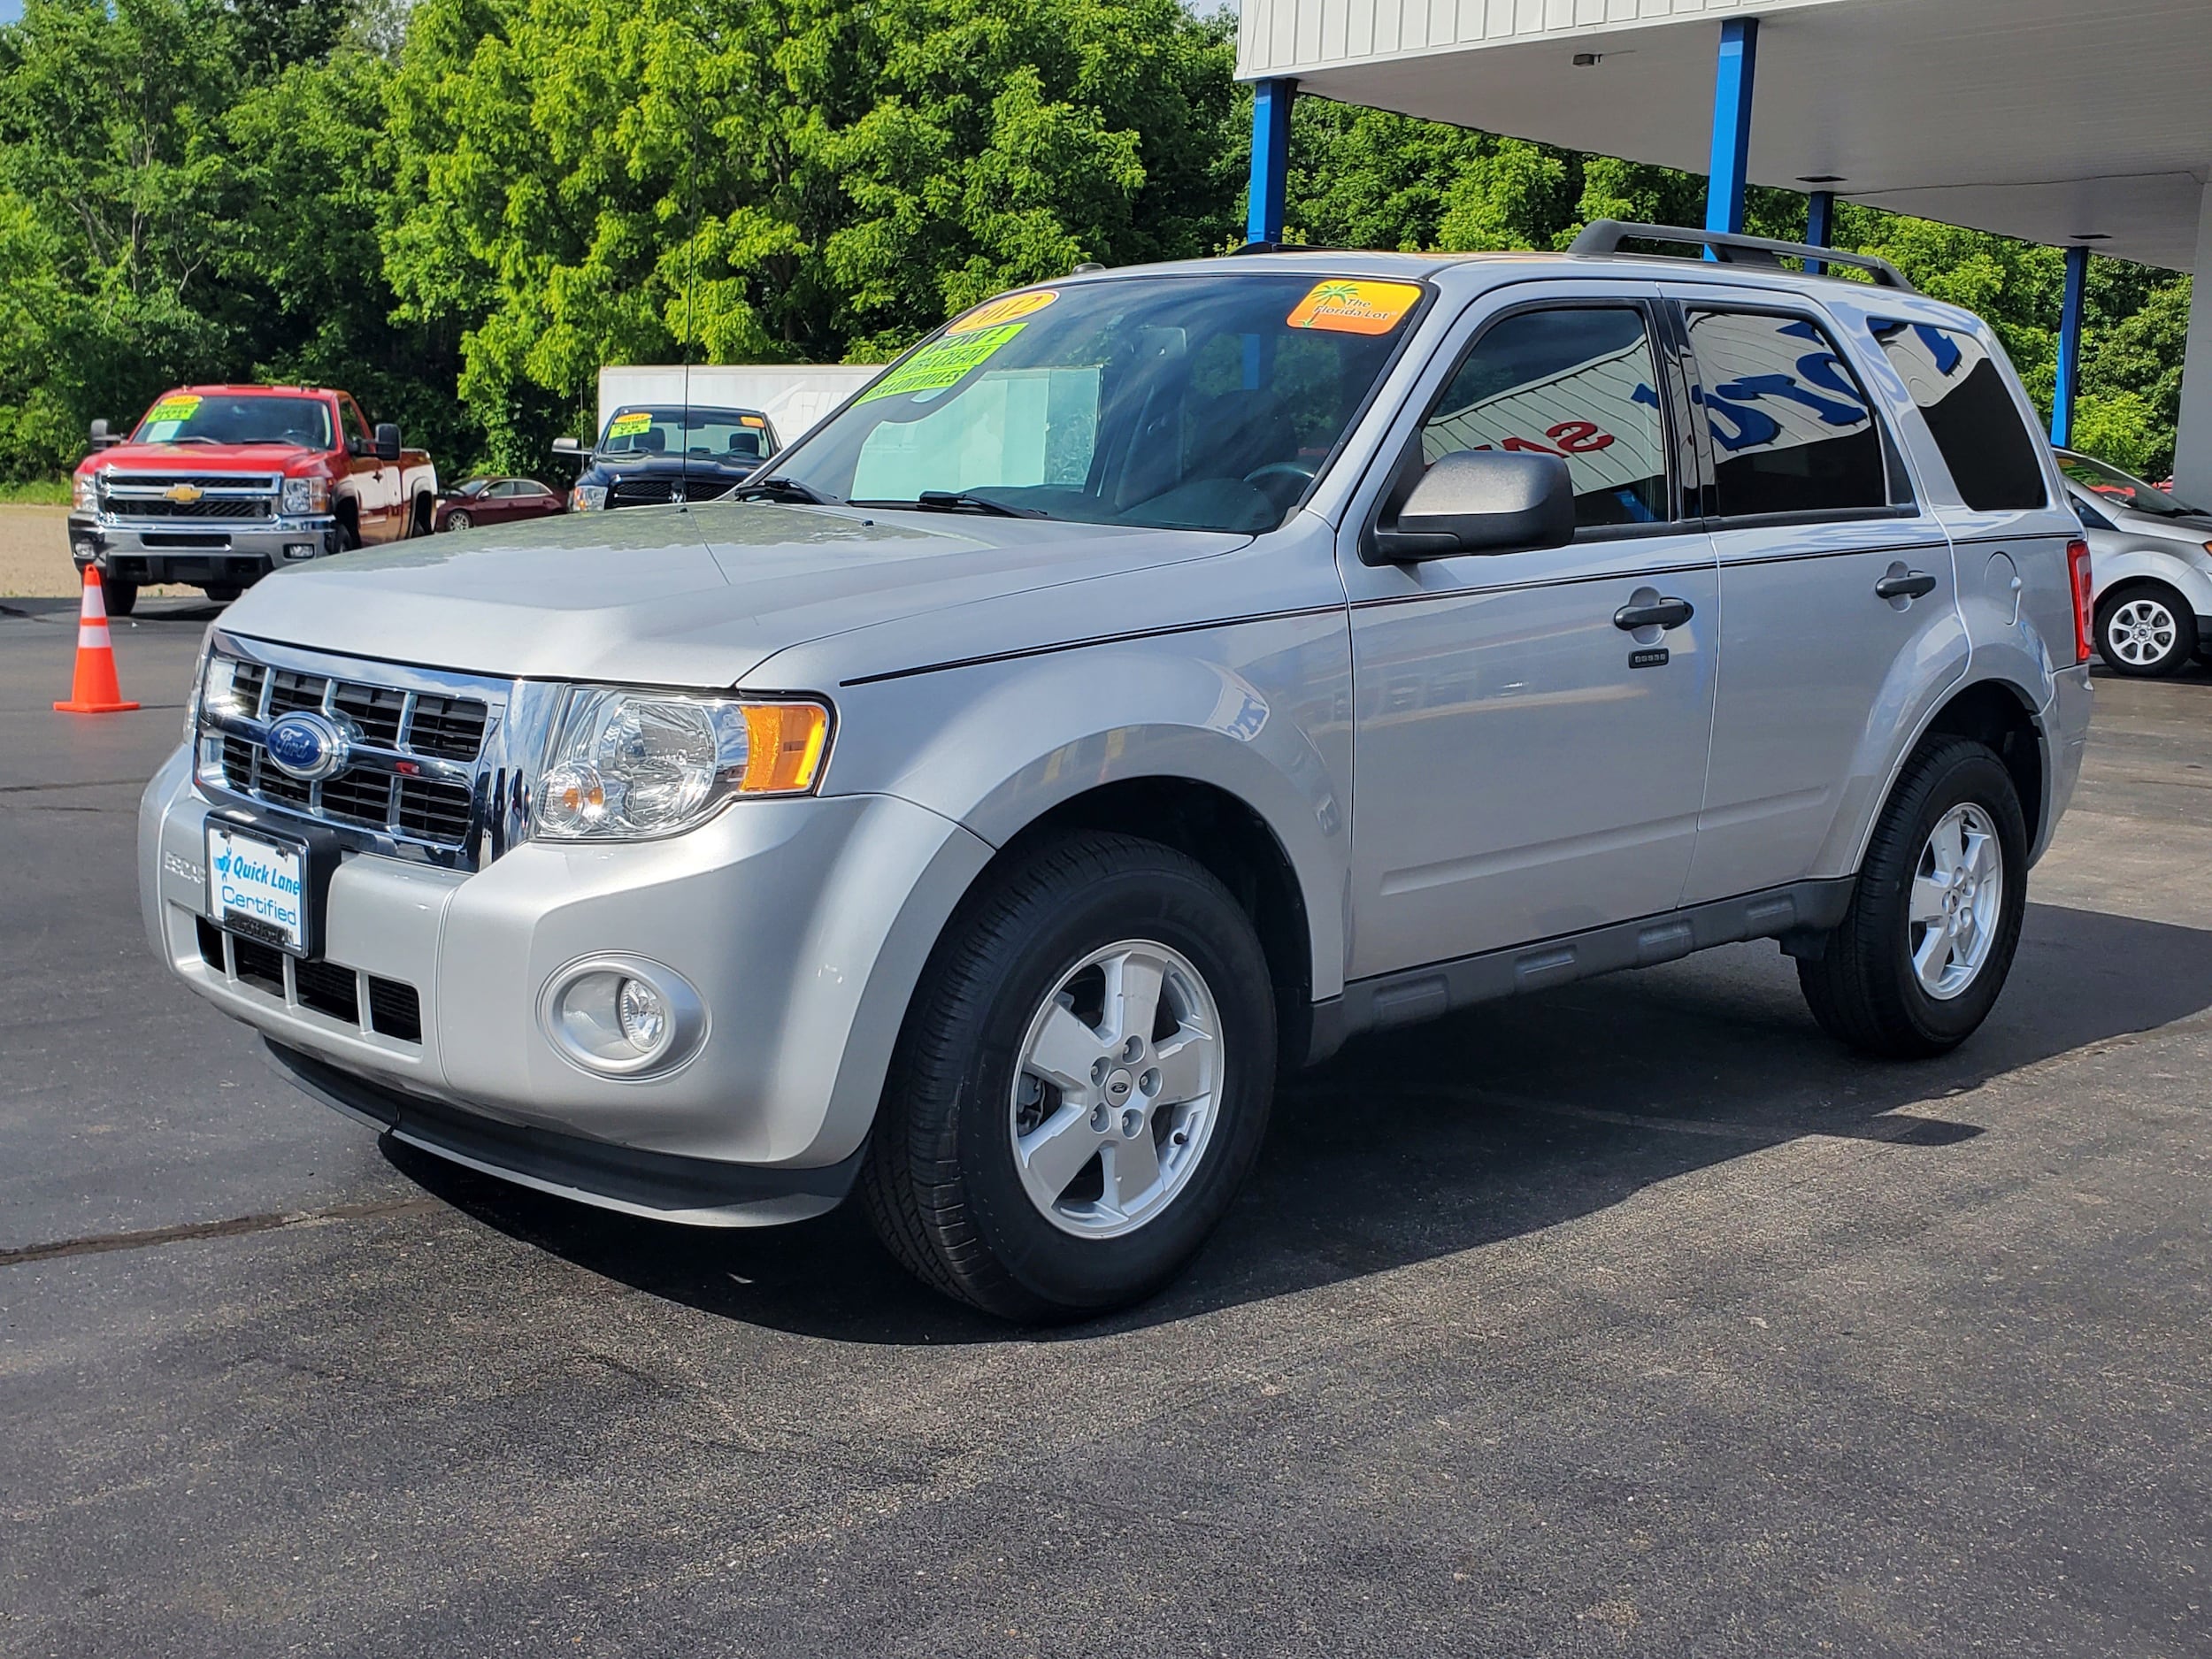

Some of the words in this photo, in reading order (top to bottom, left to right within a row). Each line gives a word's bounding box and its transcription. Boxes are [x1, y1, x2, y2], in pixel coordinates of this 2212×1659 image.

[1314, 305, 1362, 317] Florida
[1364, 310, 1388, 319] Lot
[1347, 299, 1371, 308] The
[932, 346, 992, 368] CLEAN
[914, 368, 966, 388] MILES
[275, 727, 310, 759] Ford
[165, 851, 205, 884] ESCAP
[233, 856, 269, 885] Quick
[271, 868, 301, 895] Lane
[222, 885, 297, 926] Certified
